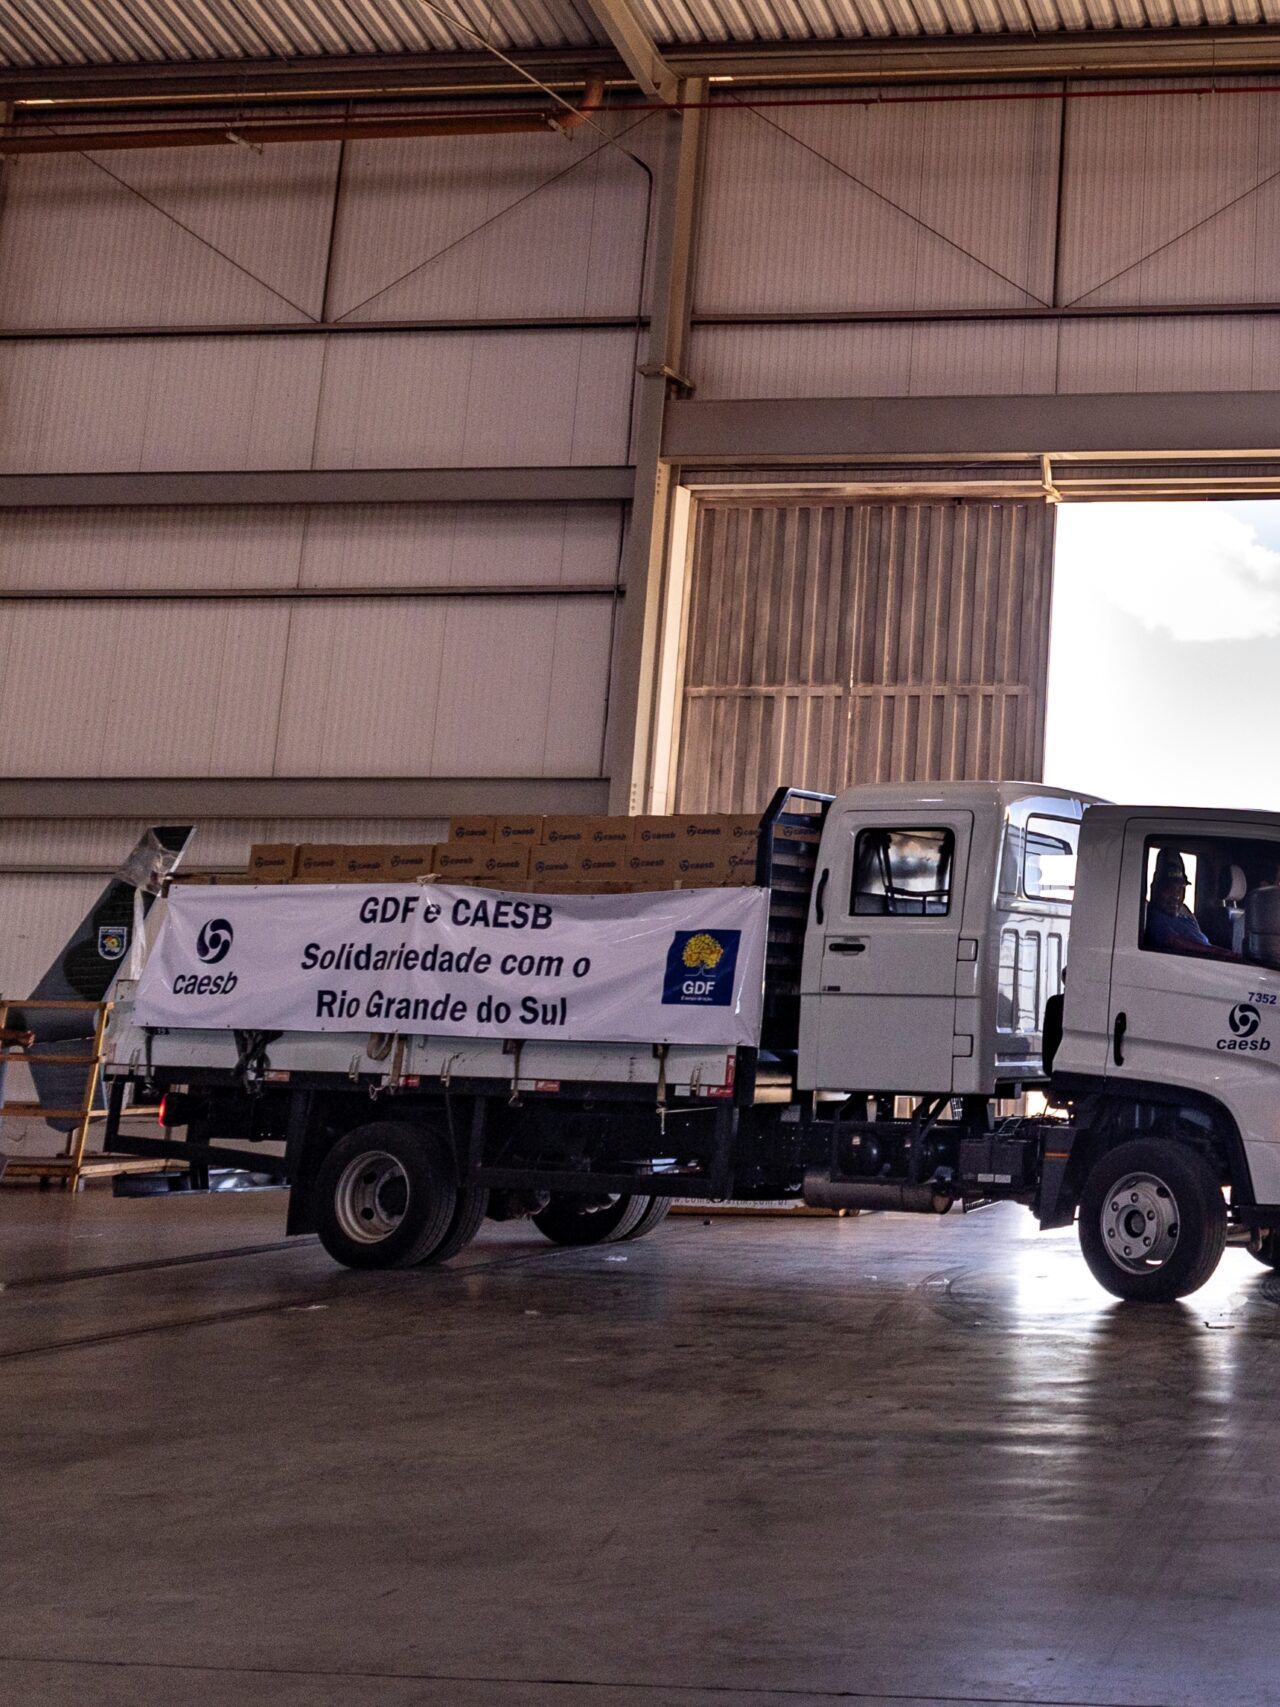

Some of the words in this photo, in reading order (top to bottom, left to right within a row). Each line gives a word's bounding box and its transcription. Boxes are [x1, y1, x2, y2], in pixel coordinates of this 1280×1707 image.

[359, 896, 419, 924] GDF
[423, 903, 442, 924] e
[451, 898, 553, 930] CAESB
[301, 942, 492, 974] Solidariedade
[500, 953, 563, 977] com
[573, 957, 591, 978] o
[172, 971, 238, 995] caesb
[682, 980, 715, 995] GDF
[316, 989, 361, 1018] Rio
[365, 990, 467, 1022] Grande
[476, 995, 511, 1024] do
[519, 996, 567, 1026] Sul
[1248, 991, 1277, 1005] 7352
[1216, 1037, 1271, 1051] caesb
